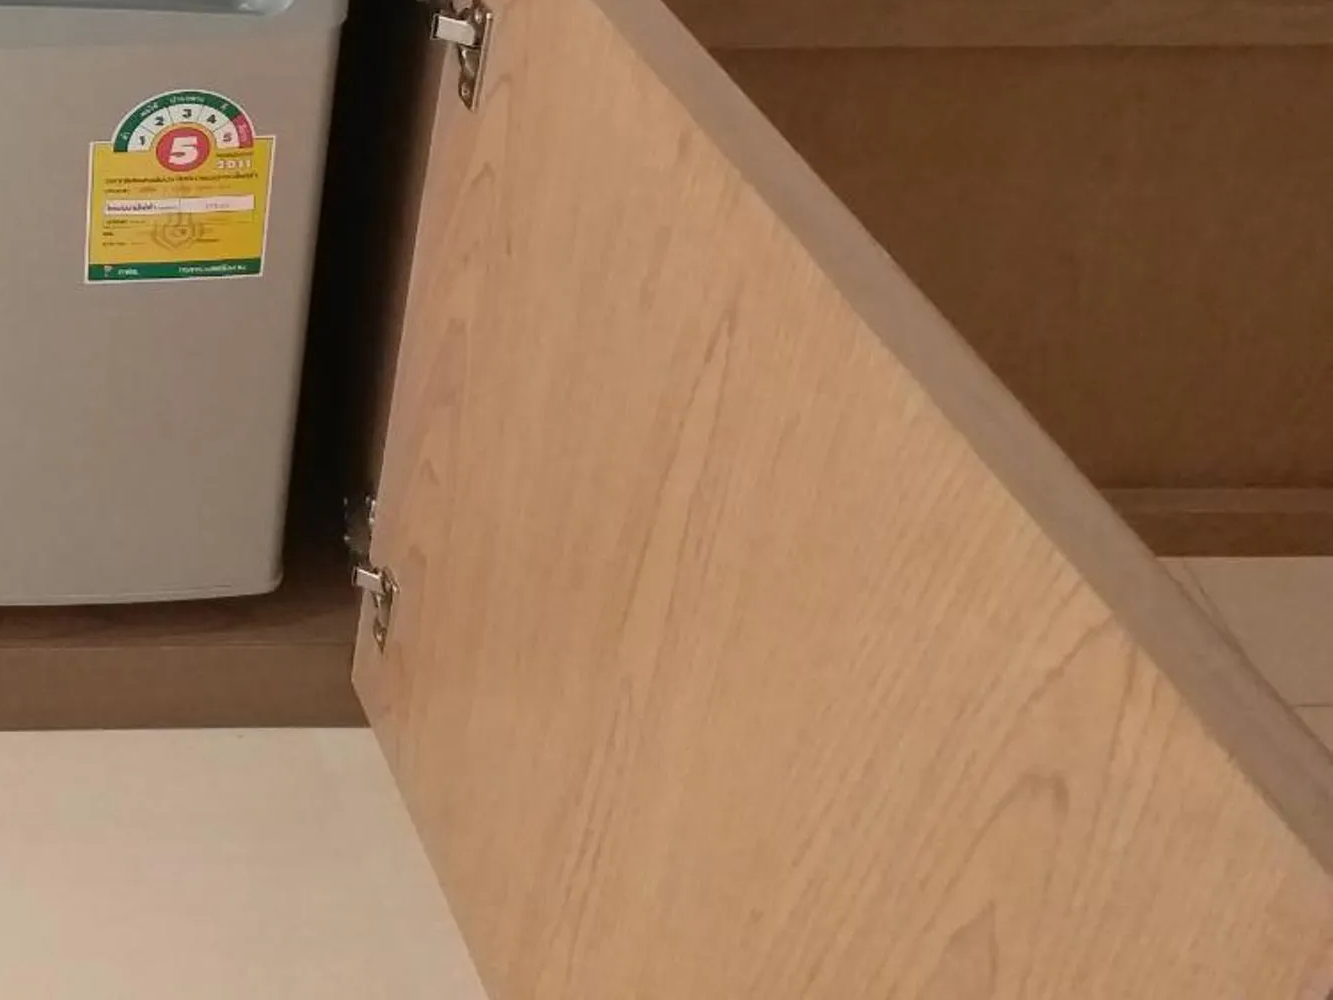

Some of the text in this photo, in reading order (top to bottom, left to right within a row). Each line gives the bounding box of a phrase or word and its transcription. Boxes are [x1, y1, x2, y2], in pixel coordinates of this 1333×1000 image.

[139, 135, 146, 146] 1
[154, 116, 164, 126] 2
[181, 108, 192, 118] 3
[206, 114, 217, 124] 4
[222, 133, 232, 143] 5
[168, 135, 199, 166] 5
[217, 159, 251, 169] 2011
